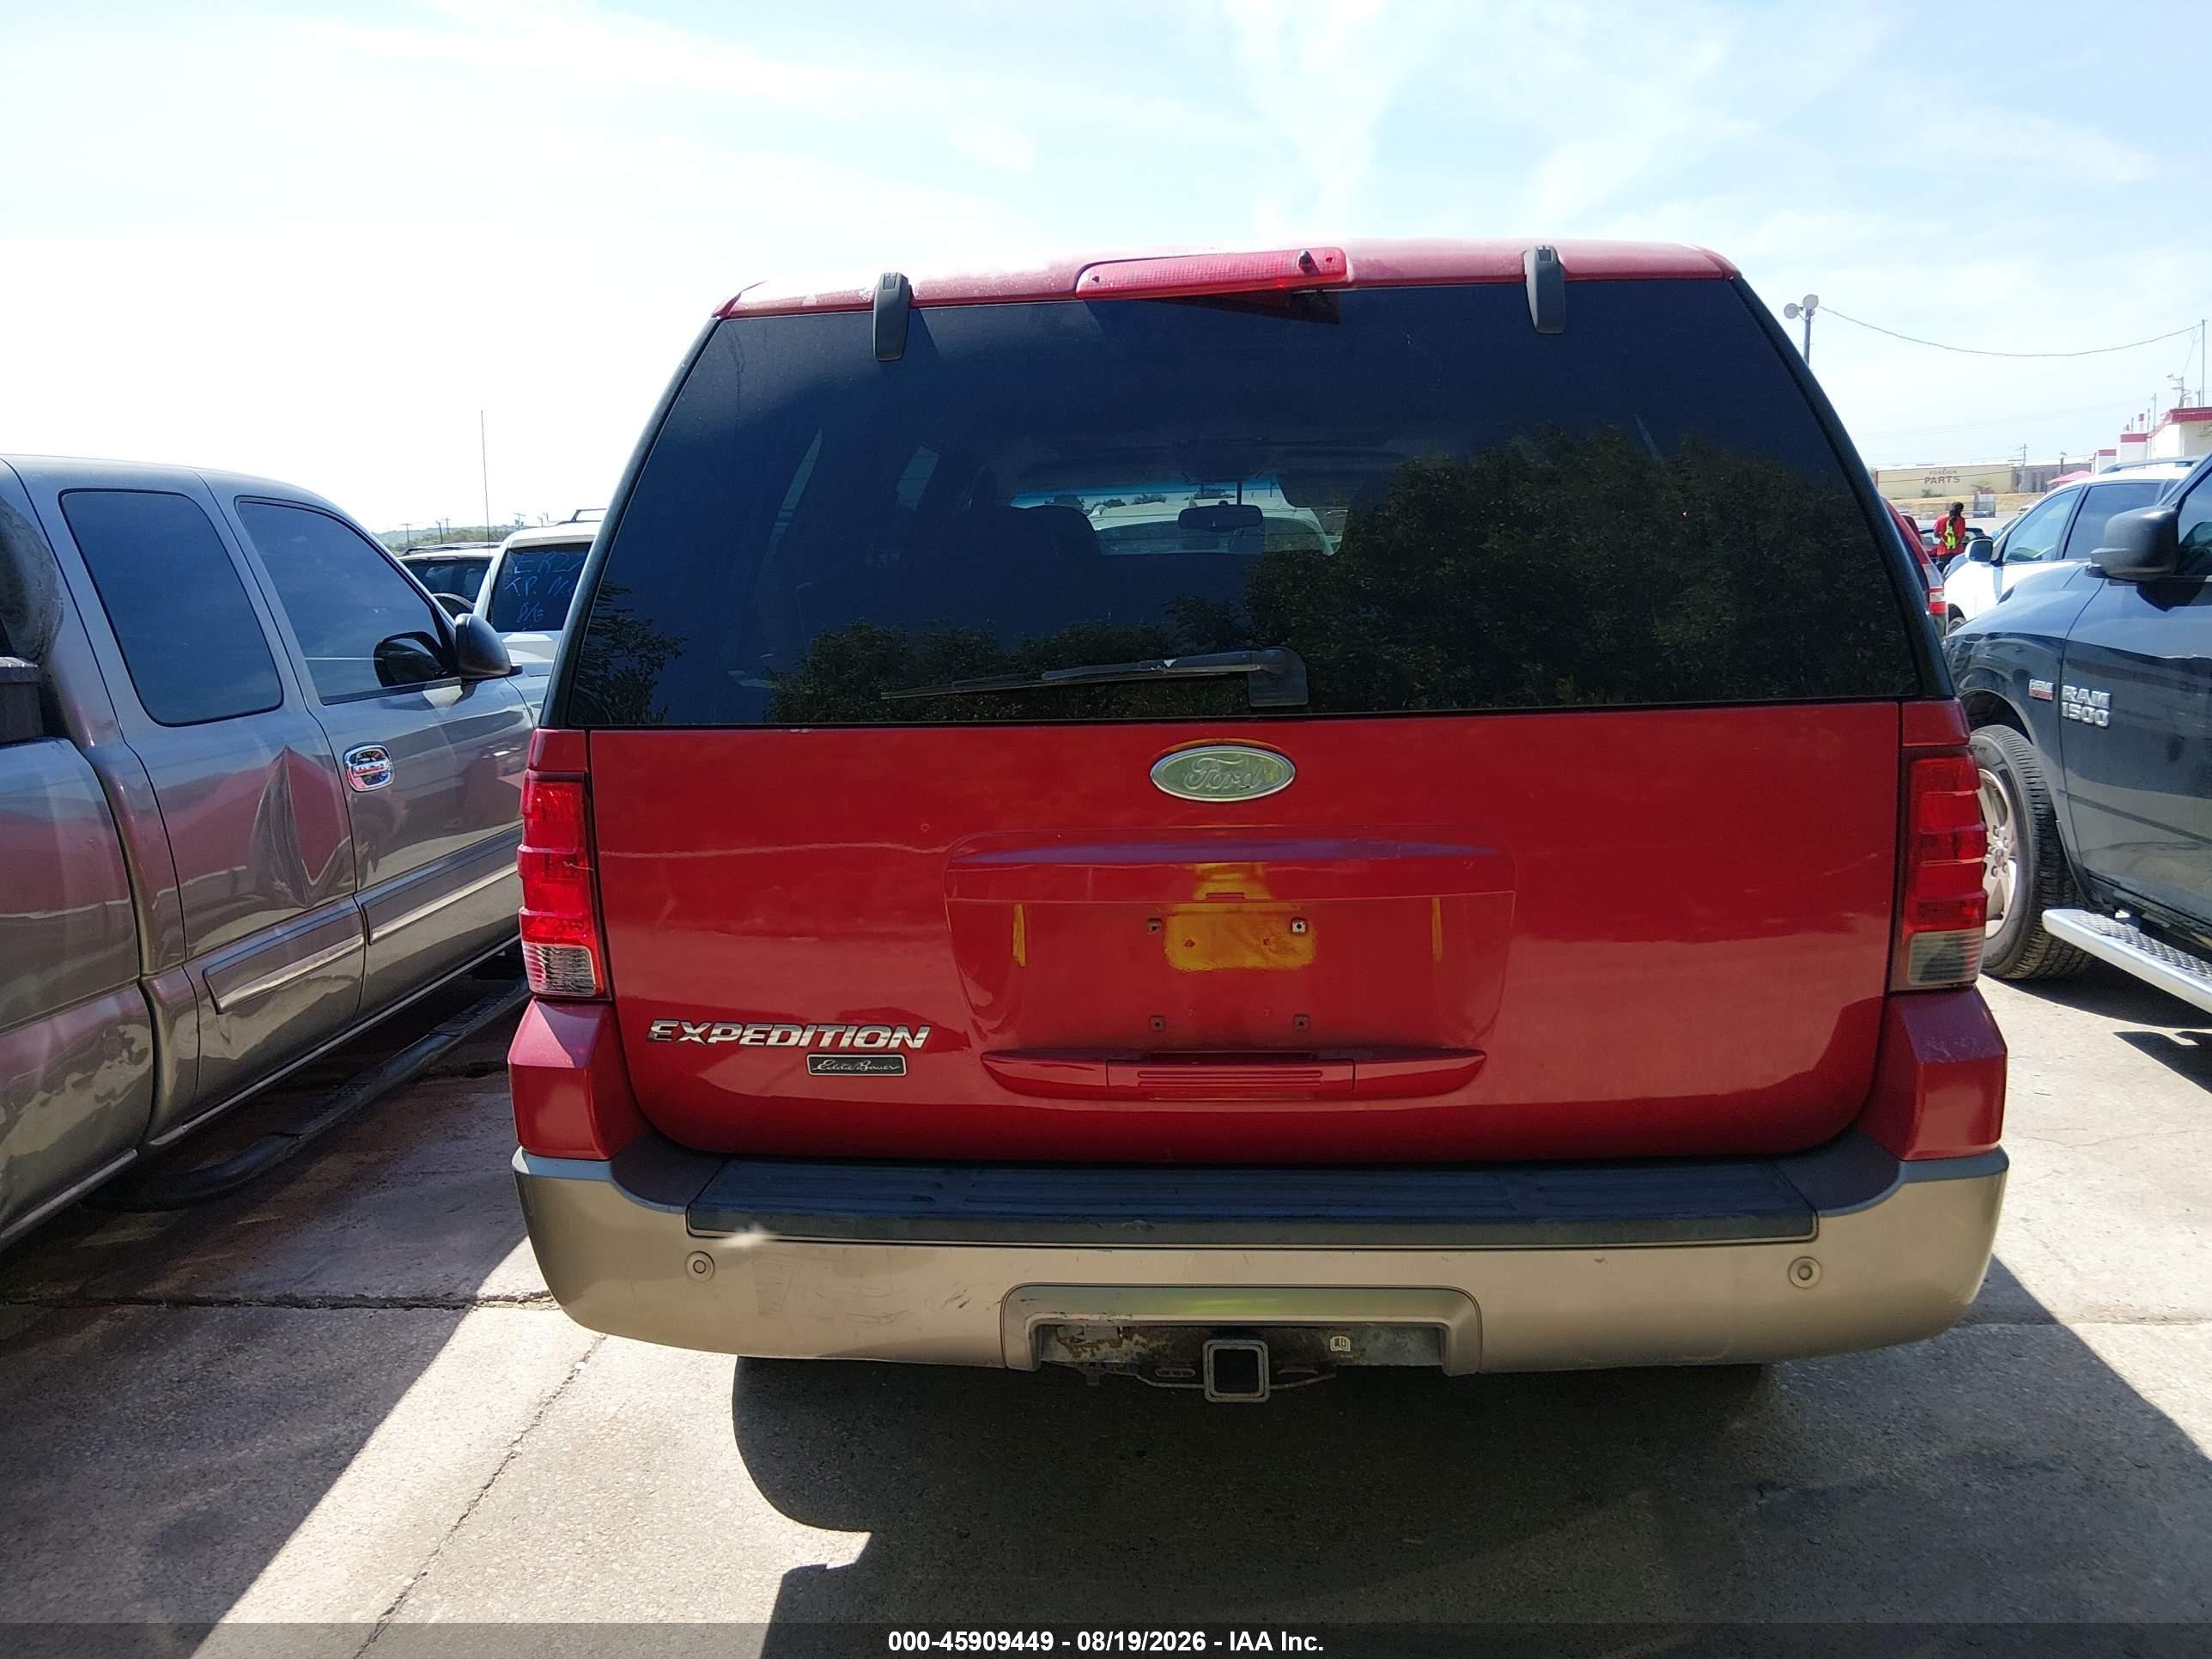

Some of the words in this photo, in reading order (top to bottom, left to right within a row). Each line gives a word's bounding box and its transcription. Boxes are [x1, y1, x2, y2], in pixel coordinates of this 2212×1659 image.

[1924, 476, 1960, 484] PARTS
[2062, 685, 2112, 709] RAM
[2062, 702, 2110, 727] 1500
[1183, 757, 1265, 791] Ford
[647, 1019, 931, 1050] EXPEDITION
[812, 1059, 855, 1072] Eddie
[855, 1060, 901, 1072] Bauer
